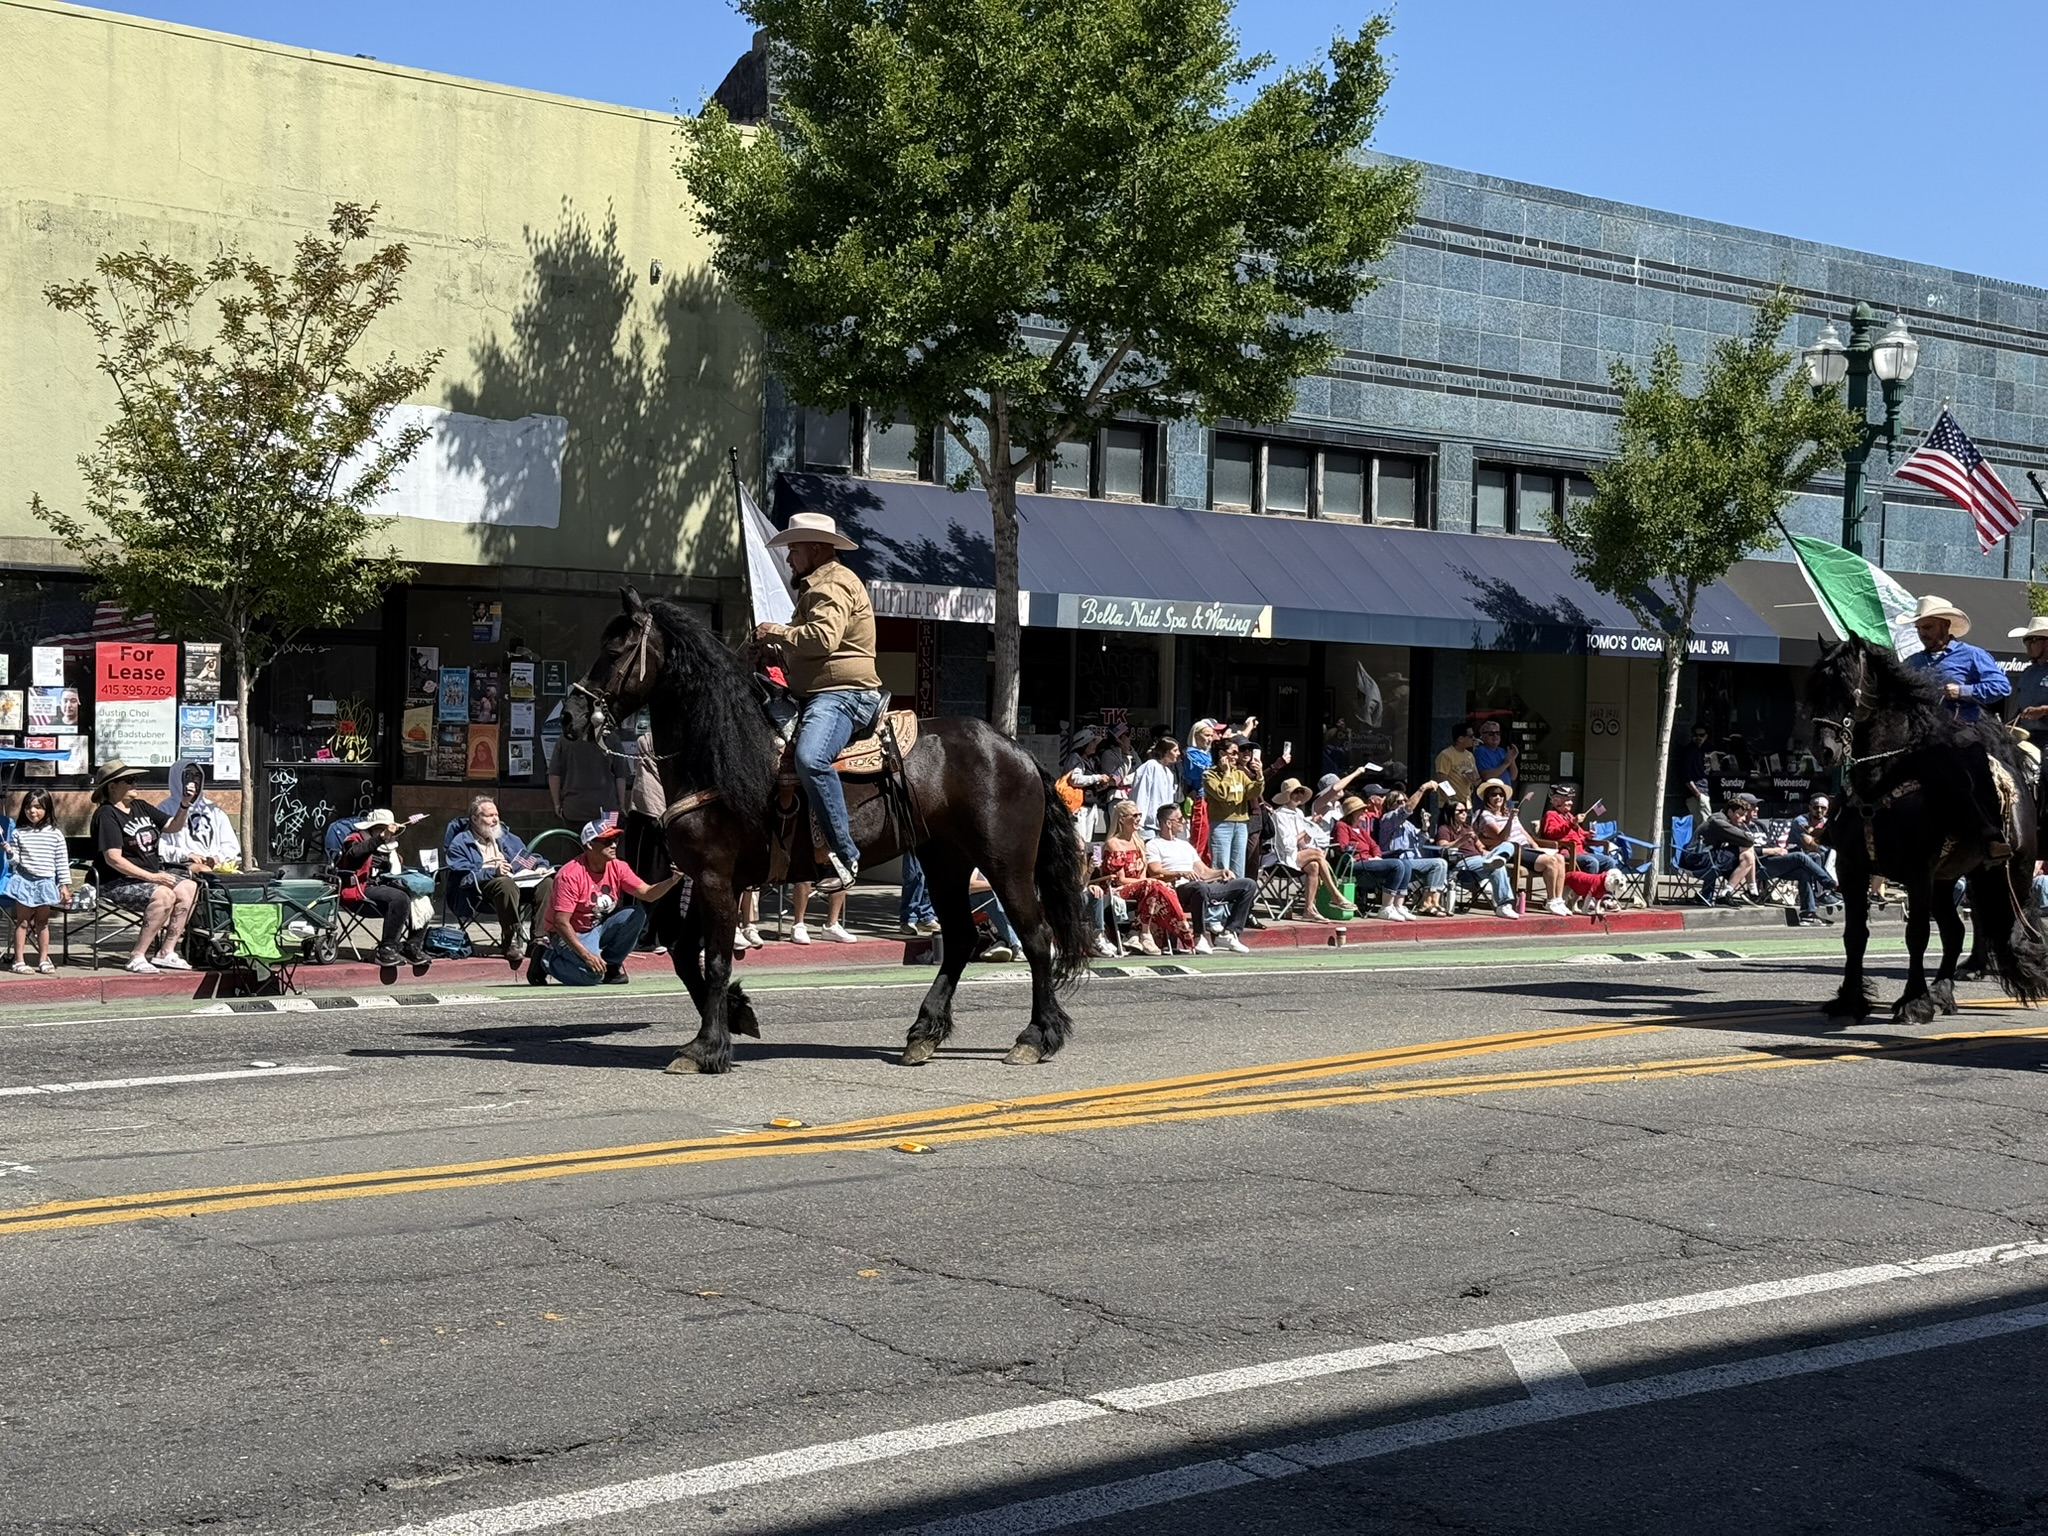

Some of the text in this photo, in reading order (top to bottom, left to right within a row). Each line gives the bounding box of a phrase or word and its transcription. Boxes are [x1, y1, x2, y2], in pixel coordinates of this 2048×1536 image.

[1081, 598, 1252, 637] Bella Nail Spa & Waxing
[1586, 634, 1730, 655] TOMO'S ORGA NAIL SPA
[121, 646, 154, 662] For
[108, 664, 166, 680] Lease
[101, 685, 172, 696] 415.395.7262
[99, 709, 149, 717] Justin Choi
[1100, 708, 1128, 725] TK
[99, 730, 165, 738] Jeff Badstubner
[1720, 777, 1746, 789] Sunday
[1773, 777, 1811, 789] Wednesday
[1722, 790, 1731, 800] 10
[1784, 790, 1799, 802] 7 pm
